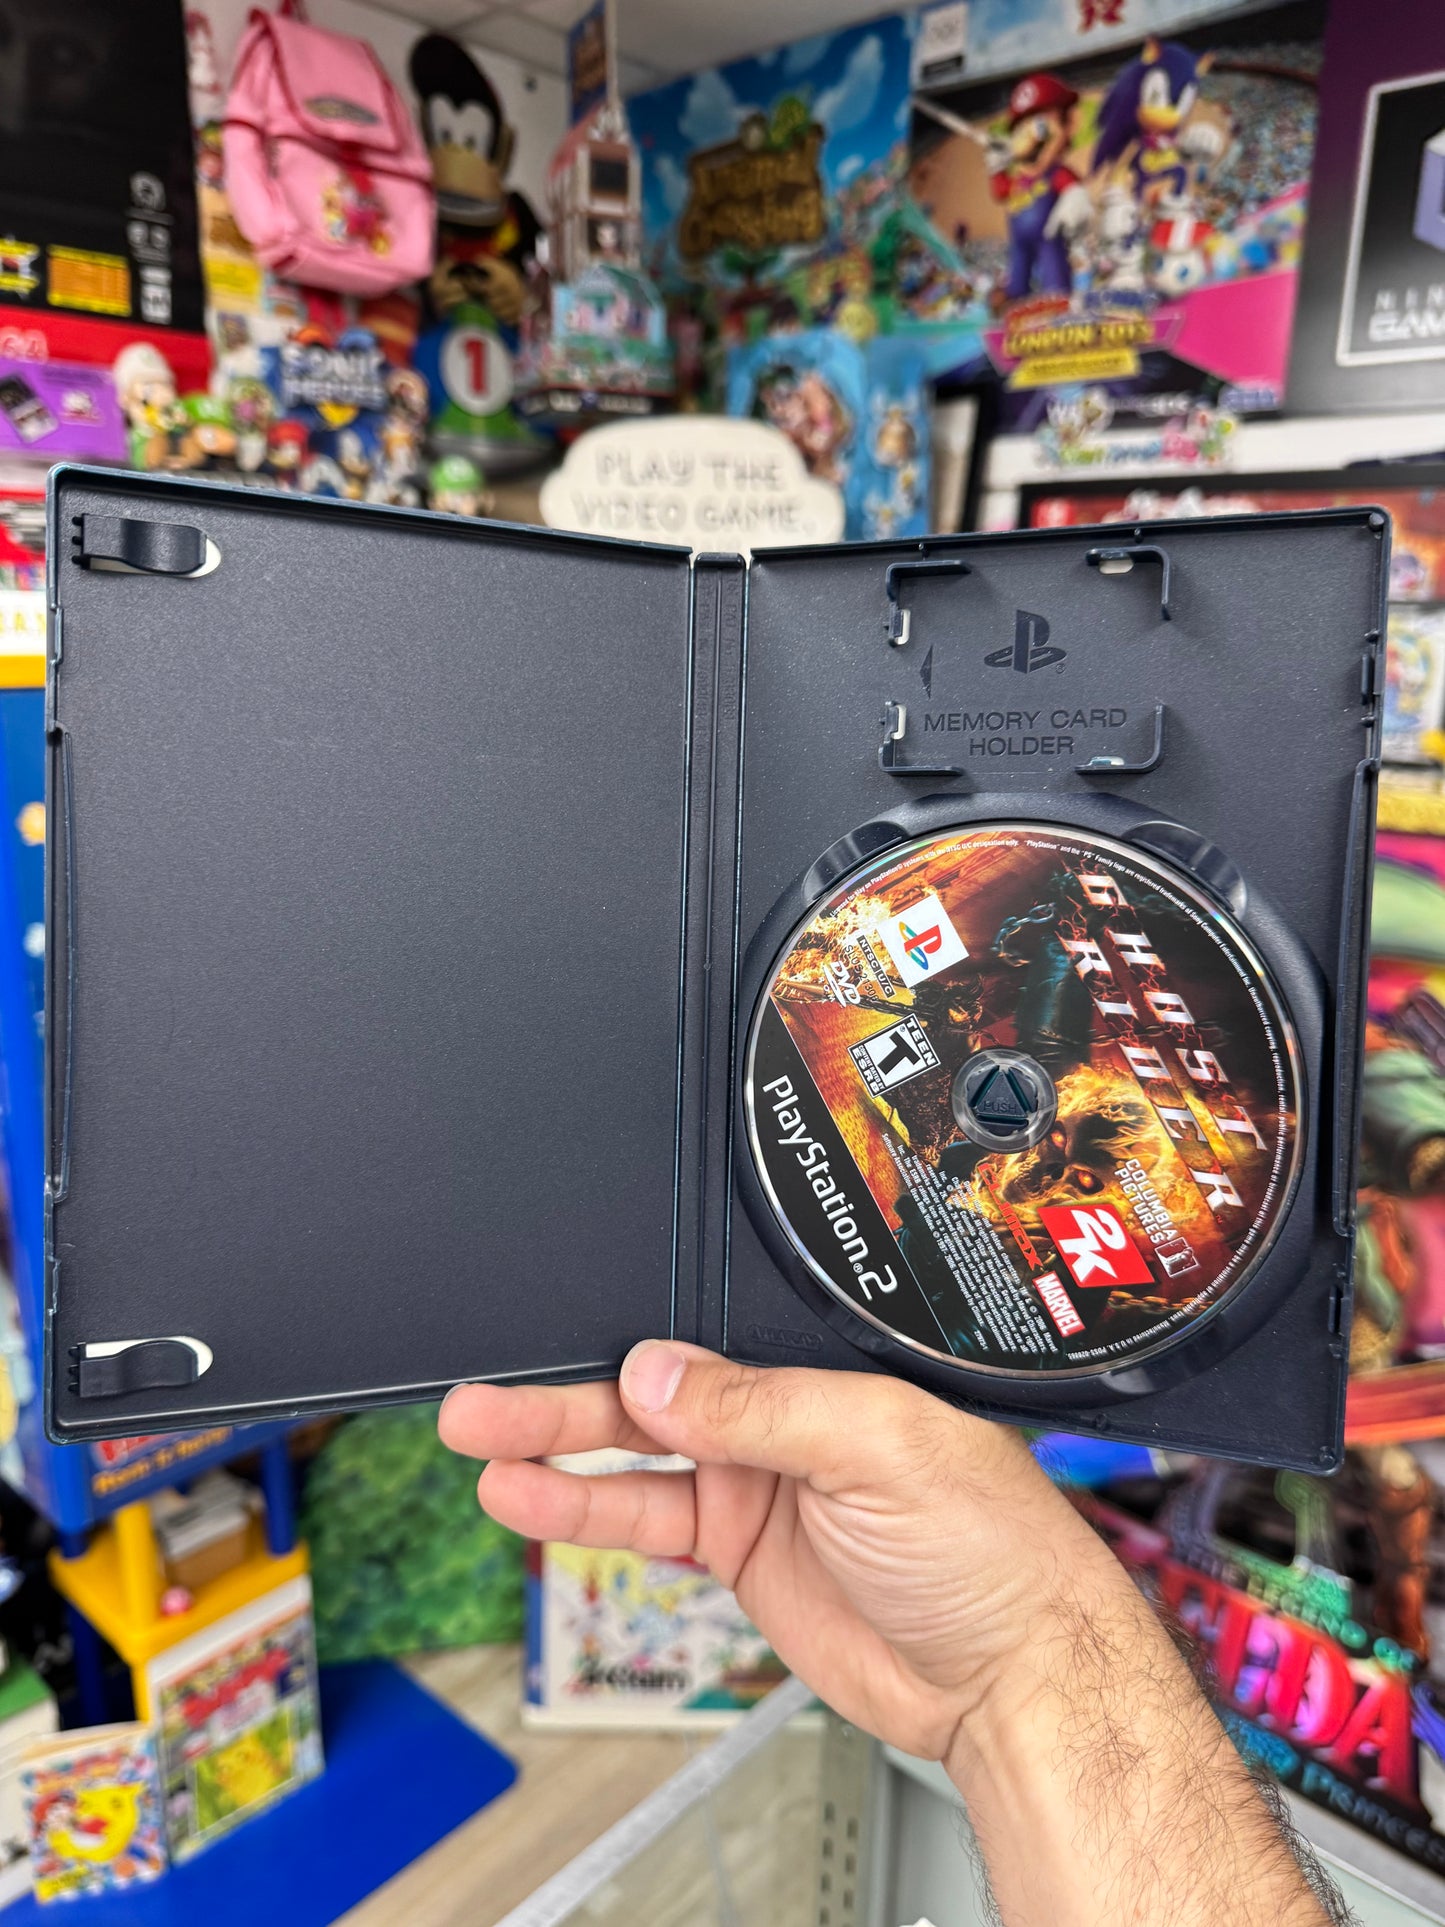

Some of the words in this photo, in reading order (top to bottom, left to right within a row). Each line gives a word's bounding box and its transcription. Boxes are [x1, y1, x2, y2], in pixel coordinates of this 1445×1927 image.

[595, 444, 696, 487] PLAY
[701, 451, 785, 491] THE
[571, 490, 687, 532] VIDEO
[924, 711, 1041, 733] MEMORY
[1051, 709, 1127, 730] CARD
[969, 736, 1074, 756] HOLDER
[972, 838, 1004, 849] designation
[1060, 845, 1070, 853] and
[1070, 847, 1080, 855] the
[1112, 861, 1126, 873] logo
[1124, 867, 1135, 876] are
[1133, 872, 1161, 892] registered
[1158, 886, 1187, 910] trademarks
[1184, 906, 1193, 915] of
[1188, 910, 1204, 926] Sony
[1198, 920, 1223, 946] Computer
[845, 944, 863, 974] SLUS
[859, 938, 878, 969] NTSC
[878, 973, 893, 995] U/C
[830, 961, 861, 1004] DVD
[1077, 874, 1268, 1150] GHOST
[877, 1030, 921, 1076] T
[906, 1017, 937, 1067] TEEN
[851, 1047, 880, 1093] ESRB
[857, 1045, 872, 1067] CONTENT
[869, 1066, 880, 1082] RATED
[877, 1082, 884, 1090] BY
[1062, 938, 1245, 1211] RIDER
[984, 1100, 1017, 1113] PUSH
[1276, 1116, 1288, 1135] public
[1268, 1135, 1287, 1174] performance
[1114, 1168, 1165, 1244] PICTURES
[1125, 1159, 1178, 1240] COLUMBIA
[1259, 1181, 1278, 1212] broadcast
[880, 1132, 898, 1157] Software
[909, 1187, 921, 1202] Uses
[916, 1200, 927, 1214] Bink
[951, 1269, 972, 1299] Developed
[959, 1209, 977, 1236] Columbia
[973, 1218, 981, 1227] All
[1251, 1216, 1265, 1230] this
[910, 1154, 931, 1186] trademarks
[927, 1184, 941, 1204] and/or
[935, 1202, 956, 1232] registered
[950, 1230, 972, 1263] trademarks
[970, 1268, 989, 1295] Take-Two
[983, 1294, 1004, 1325] Interactive
[974, 1237, 988, 1257] TriStar
[976, 1225, 990, 1244] rights
[1058, 1208, 1126, 1284] 2K
[1241, 1227, 1258, 1245] game
[903, 1156, 913, 1168] The
[908, 1168, 921, 1184] ESRB
[916, 1184, 932, 1204] ratings
[927, 1204, 939, 1218] icon
[941, 1231, 961, 1261] registered
[957, 1261, 977, 1290] trademark
[977, 1299, 987, 1310] the
[982, 1310, 1009, 1351] Entertainment
[985, 1242, 1003, 1269] reserved.
[981, 1215, 991, 1228] and
[988, 1229, 1003, 1250] related
[1042, 1331, 1058, 1352] Marvel
[983, 1258, 1004, 1287] Marketing
[999, 1267, 1017, 1293] Licensed
[1210, 1265, 1233, 1289] violation
[962, 1235, 973, 1247] and
[969, 1247, 987, 1273] Take-Two
[983, 1274, 1004, 1305] Interactive
[999, 1305, 1018, 1332] Software
[1013, 1331, 1023, 1343] are
[1019, 1343, 1028, 1352] all
[1034, 1271, 1082, 1335] MARVEL
[1016, 1299, 1031, 1320] Marvel
[1019, 1323, 1028, 1333] All
[1132, 1318, 1171, 1345] Manufactured
[1023, 1334, 1038, 1353] rights
